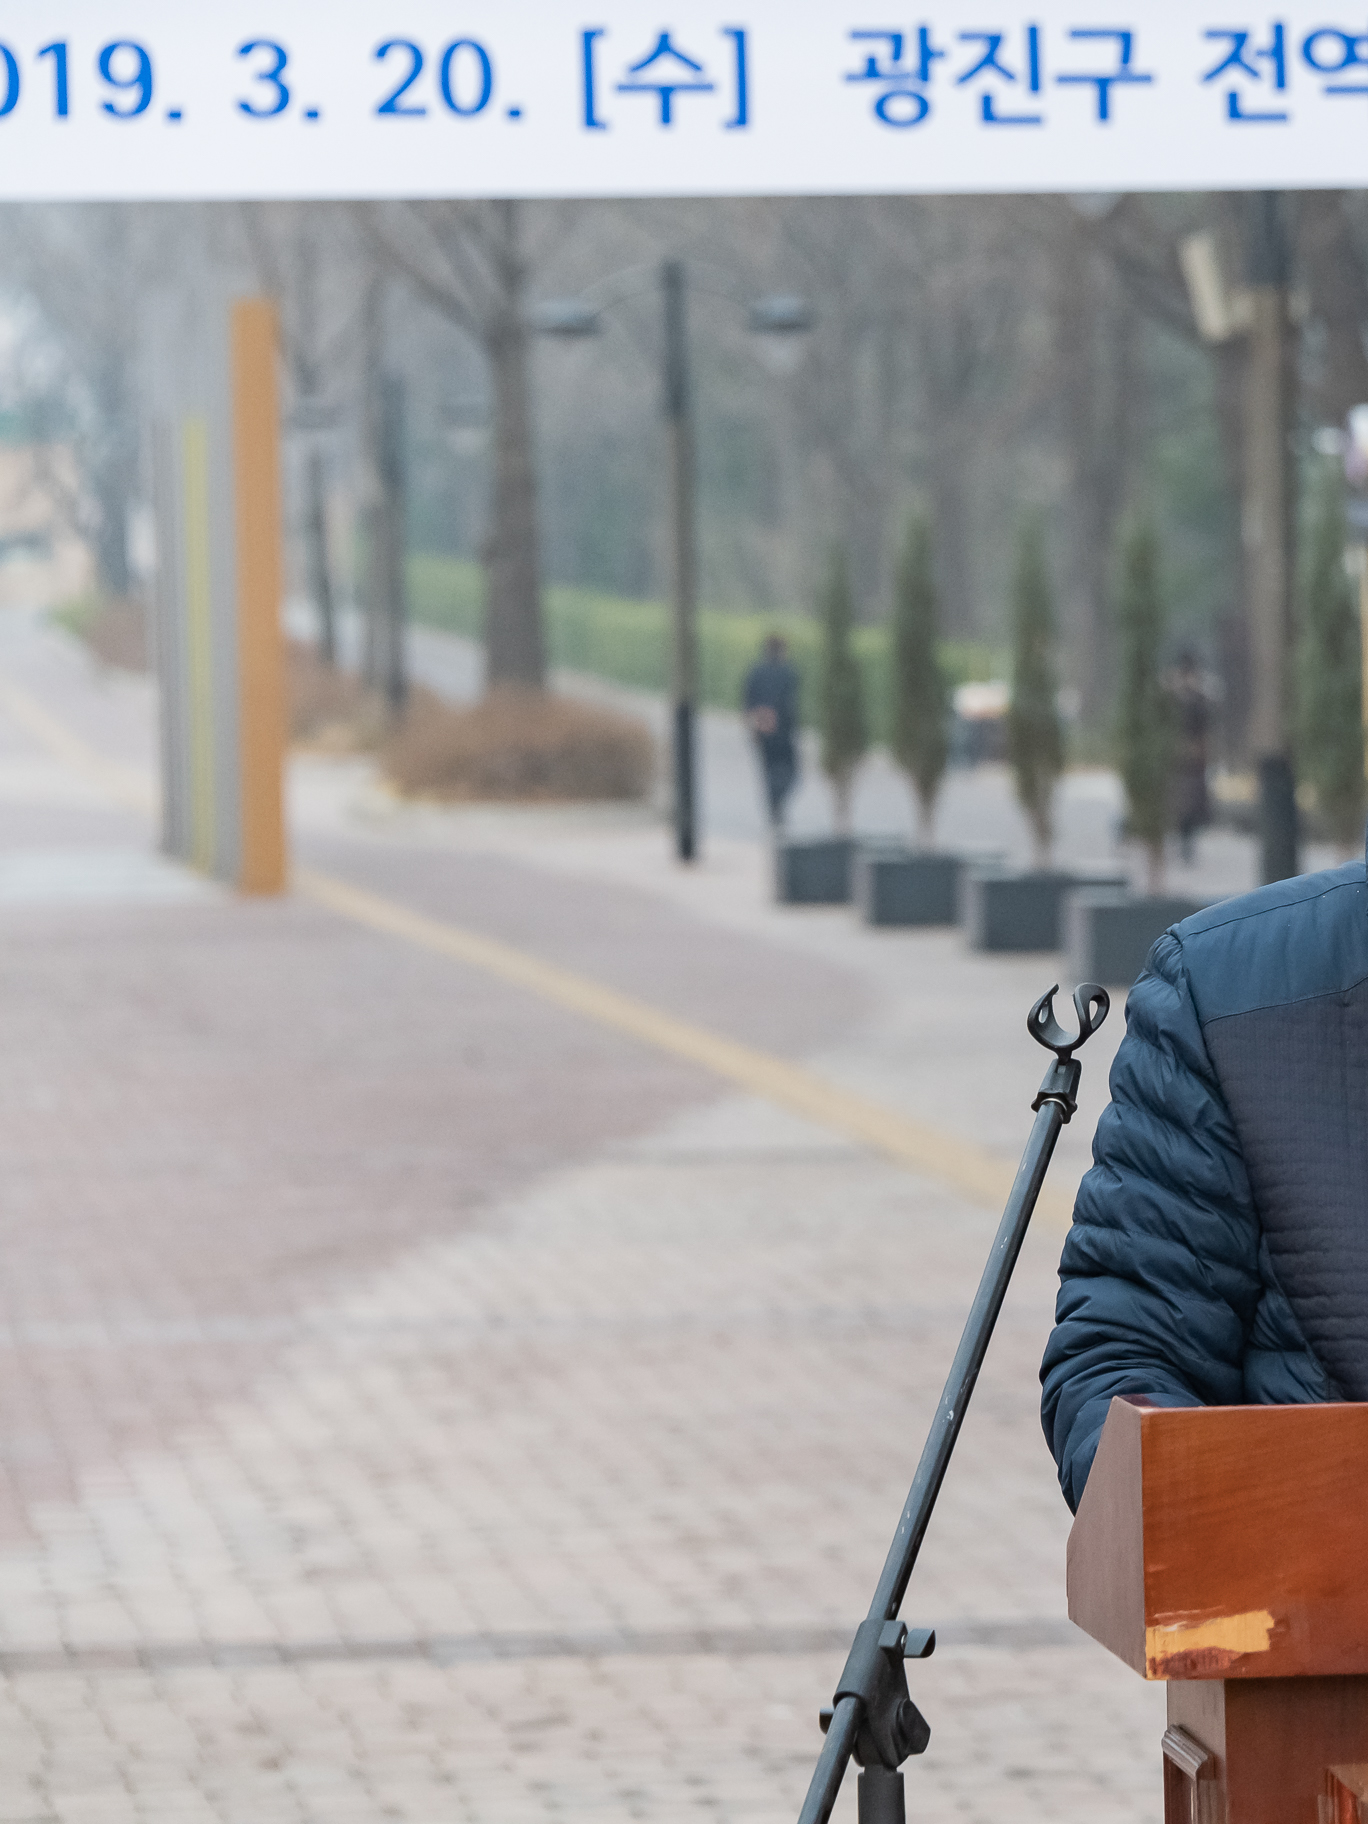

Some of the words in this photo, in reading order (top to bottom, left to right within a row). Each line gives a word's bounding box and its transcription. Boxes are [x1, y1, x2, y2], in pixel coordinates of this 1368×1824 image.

[238, 39, 321, 121] 3.
[373, 38, 524, 121] 20.
[580, 27, 751, 131] [수]
[845, 23, 1154, 130] 광진구
